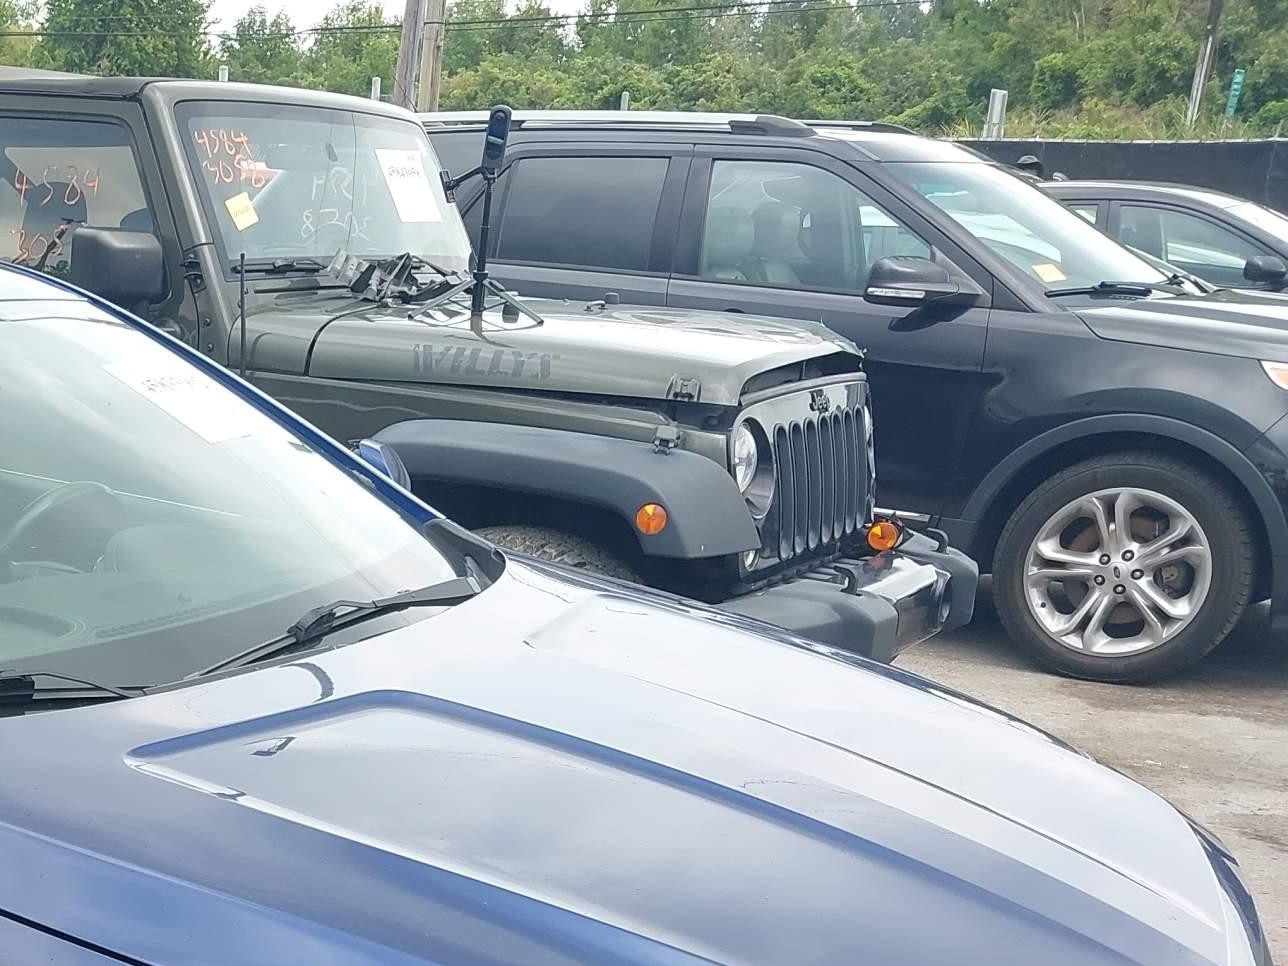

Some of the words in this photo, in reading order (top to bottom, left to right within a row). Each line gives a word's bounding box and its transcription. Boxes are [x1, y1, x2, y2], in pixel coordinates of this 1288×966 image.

[194, 127, 253, 158] 4584
[15, 167, 99, 208] 4584
[411, 343, 552, 381] WILLYS
